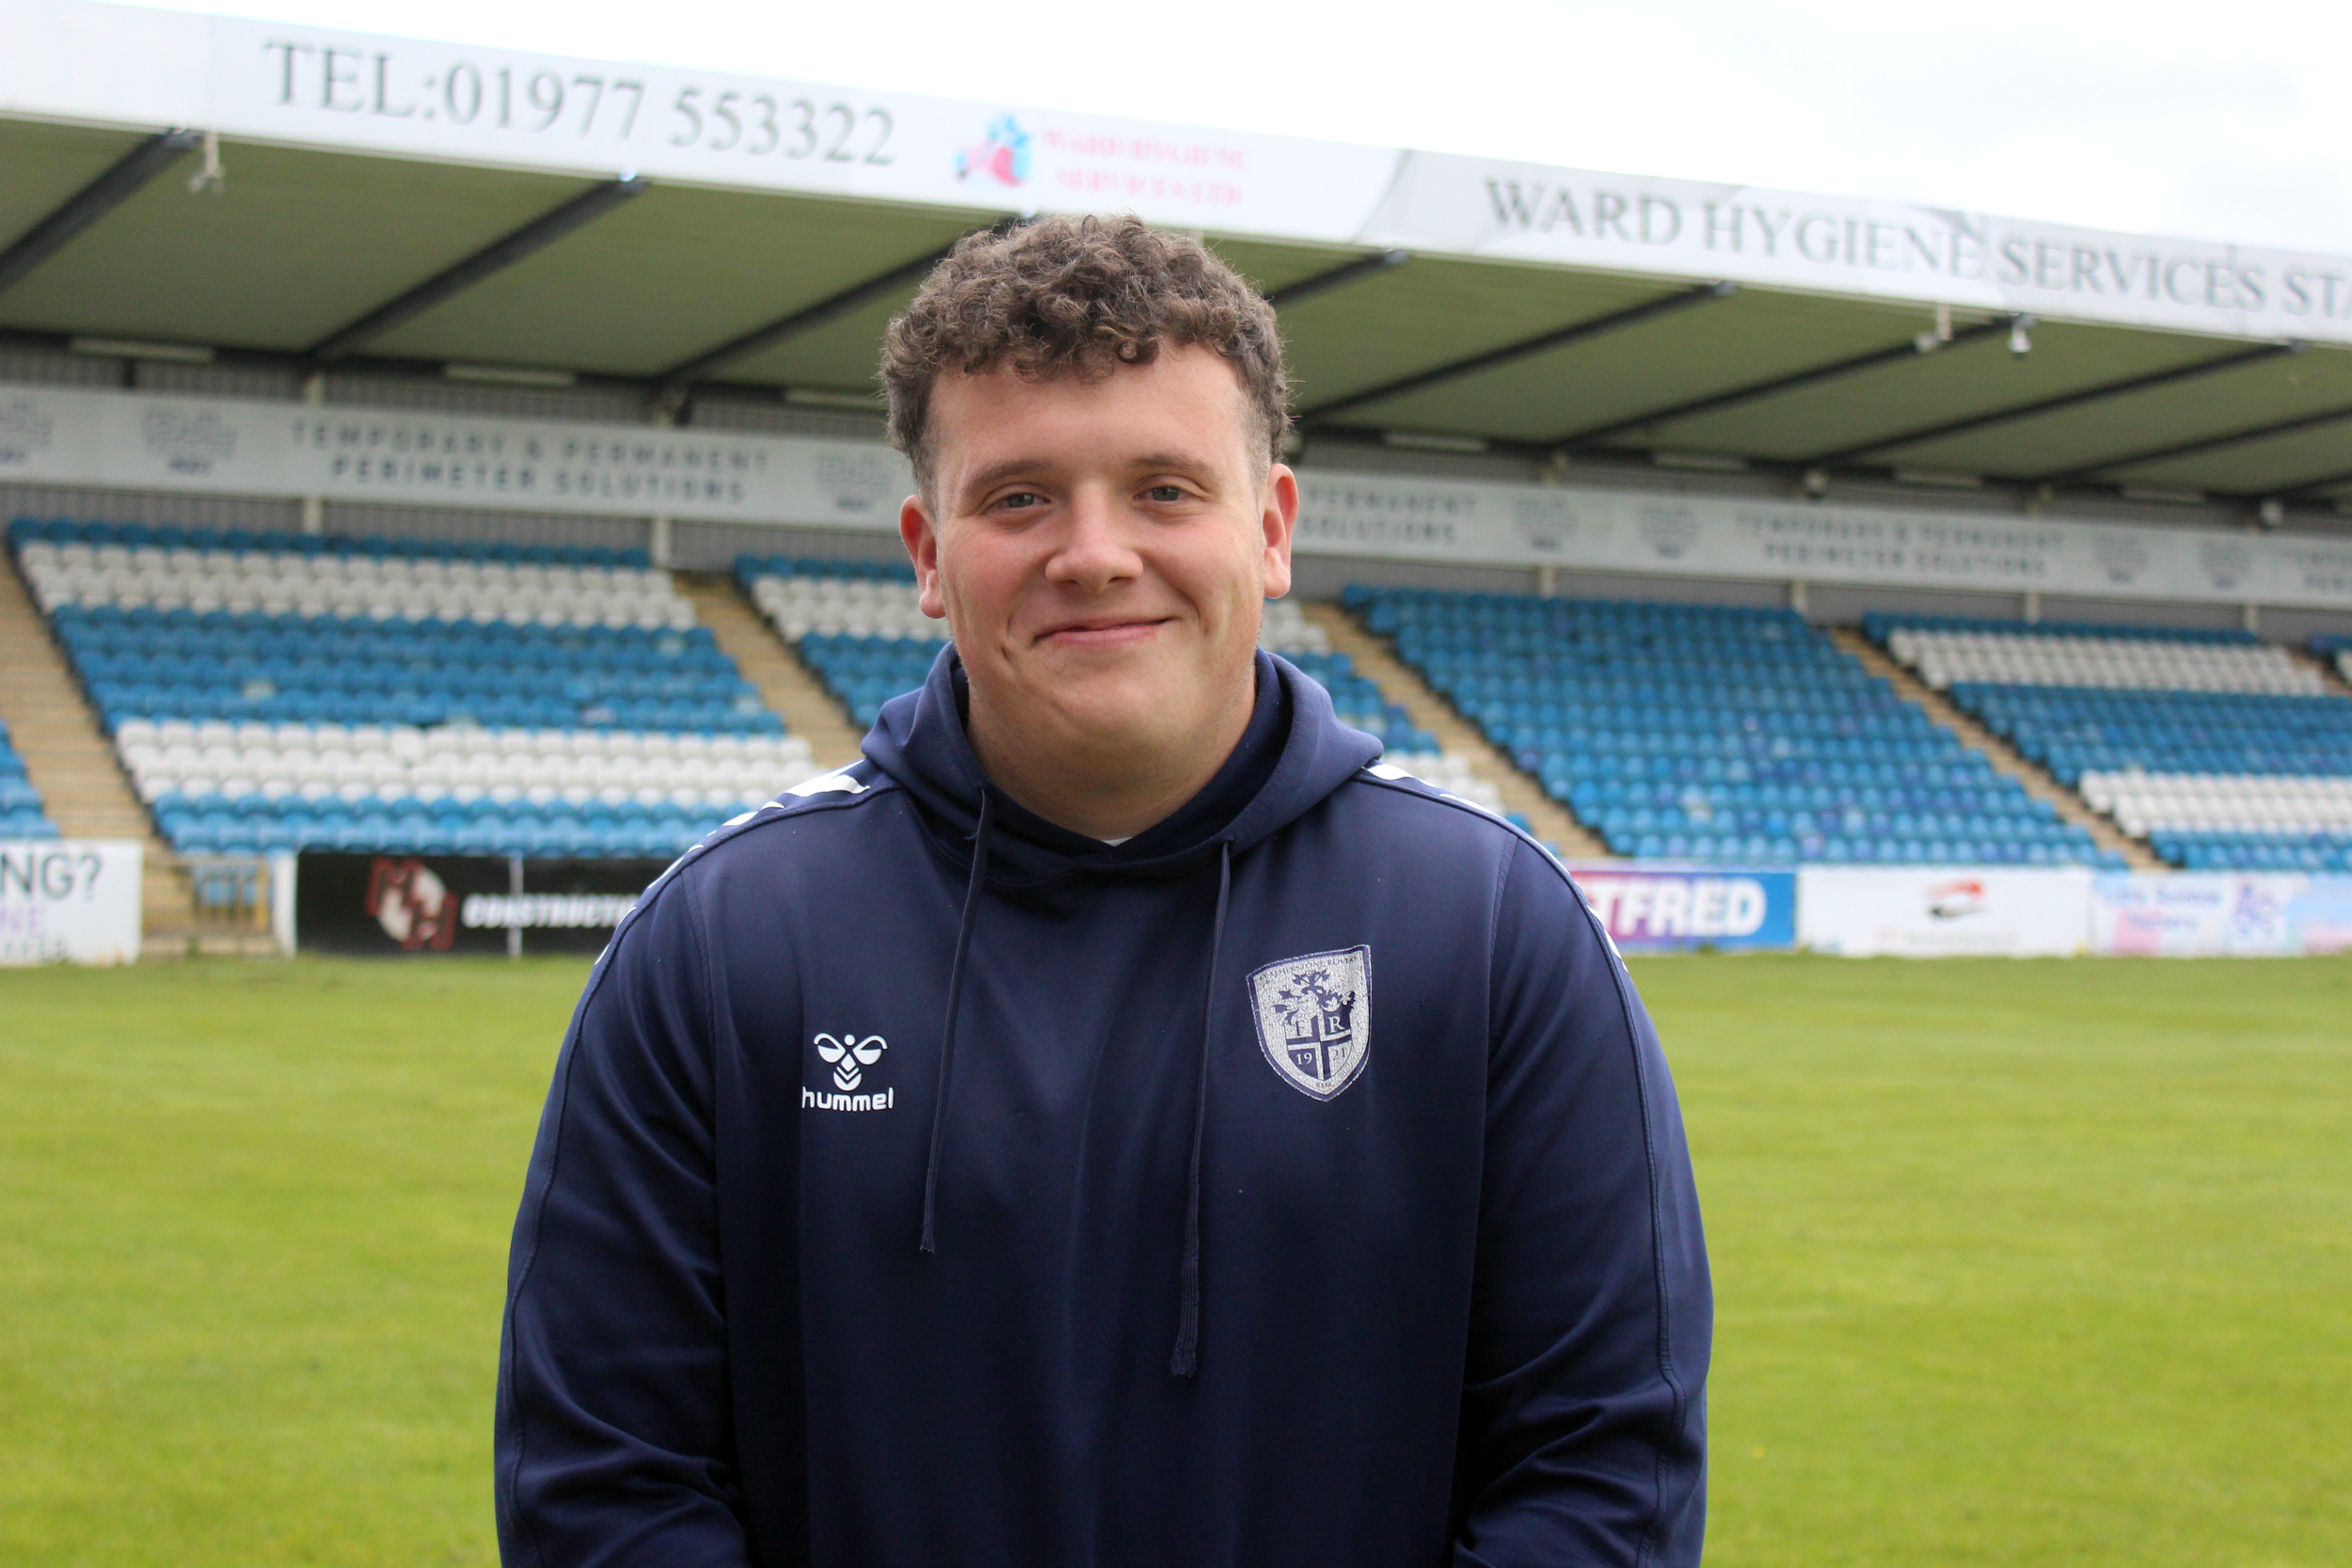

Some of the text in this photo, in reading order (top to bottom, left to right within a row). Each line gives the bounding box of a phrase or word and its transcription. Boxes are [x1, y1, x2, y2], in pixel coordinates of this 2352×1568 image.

[264, 37, 896, 166] TEL:01977 553322
[1484, 178, 1683, 245] WARD
[1703, 199, 1987, 280] HYGIENE
[1998, 232, 2267, 312] SERVICES
[293, 420, 506, 456] TEMPORARY
[564, 439, 770, 471] PERMANENT
[332, 455, 746, 505] PERIMETER SOLUTIONS
[1579, 878, 1767, 937] TFRED
[1327, 1016, 1345, 1034] R
[1295, 1048, 1346, 1066] 19 21
[802, 1085, 895, 1112] hummel
